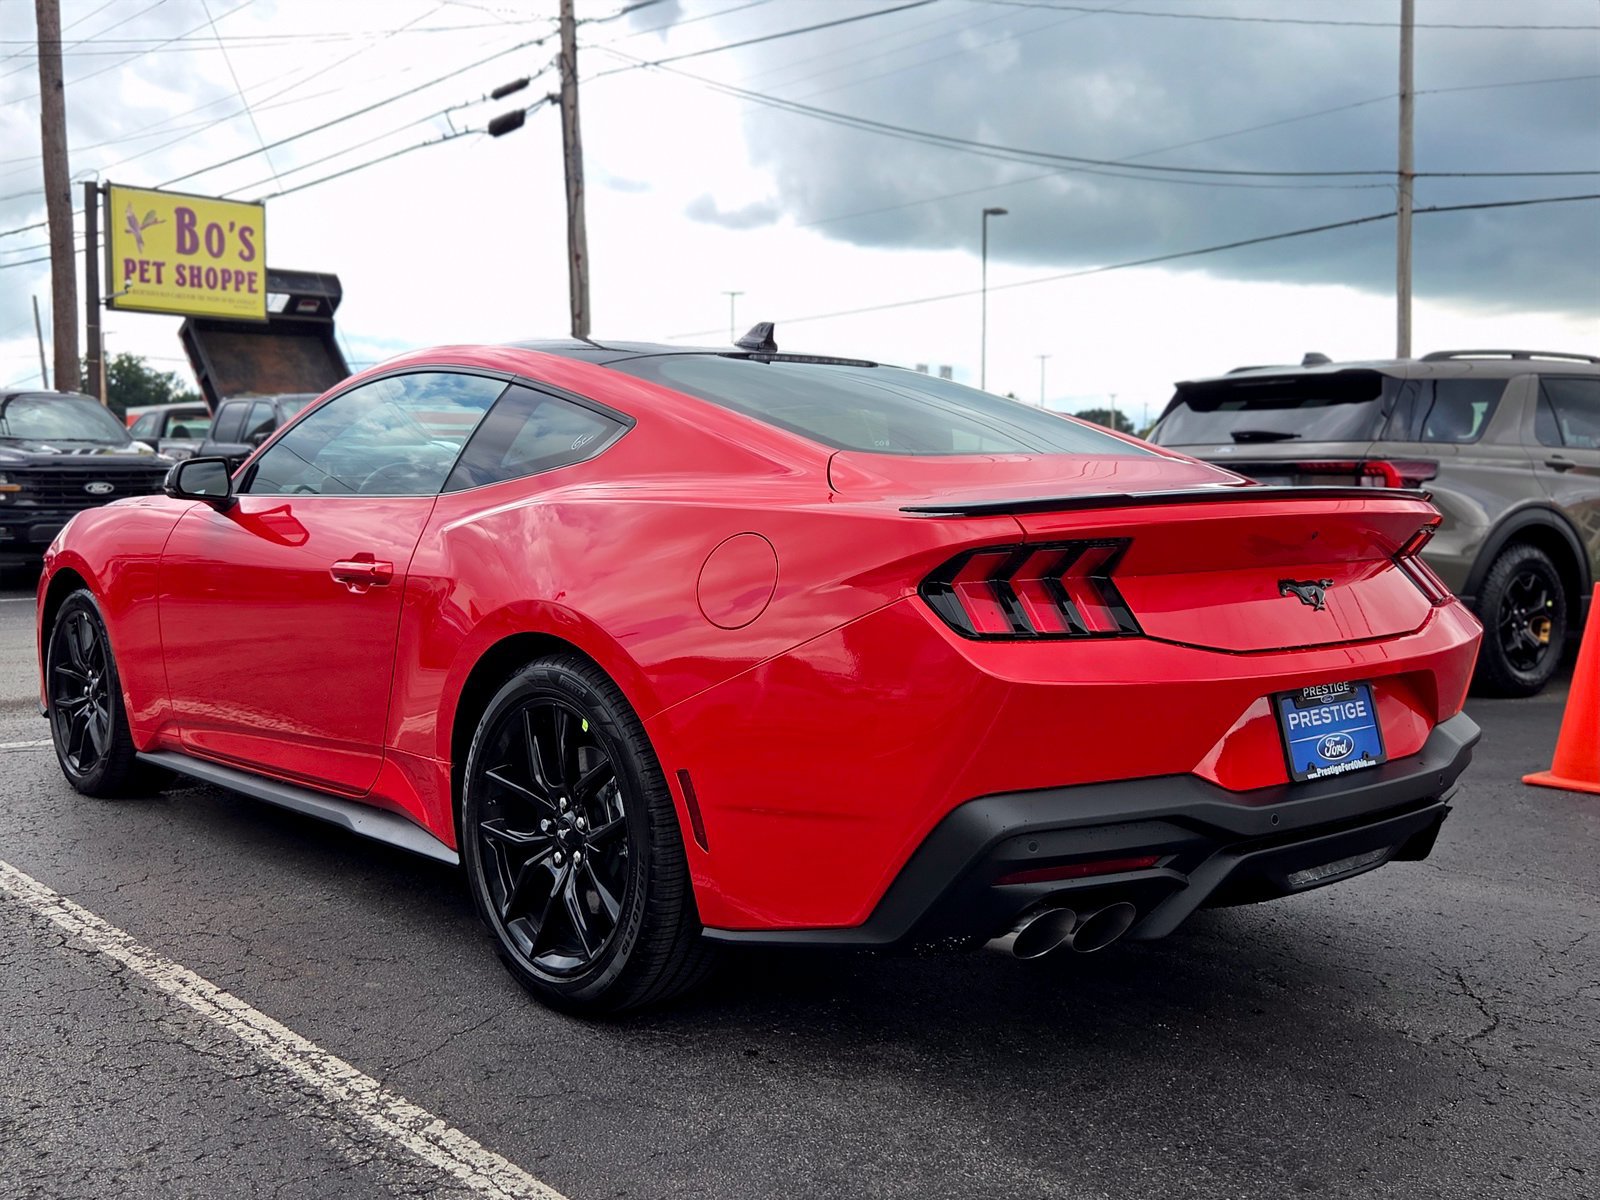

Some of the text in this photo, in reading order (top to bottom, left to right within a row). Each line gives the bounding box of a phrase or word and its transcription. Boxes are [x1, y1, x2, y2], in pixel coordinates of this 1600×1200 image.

[123, 258, 259, 294] PET SHOPPE
[1303, 681, 1350, 697] PRESTIGE
[1288, 701, 1367, 730] PRESTIGE
[1324, 736, 1348, 757] Ford
[1307, 759, 1377, 780] www.PrestigeFordOhio.com
